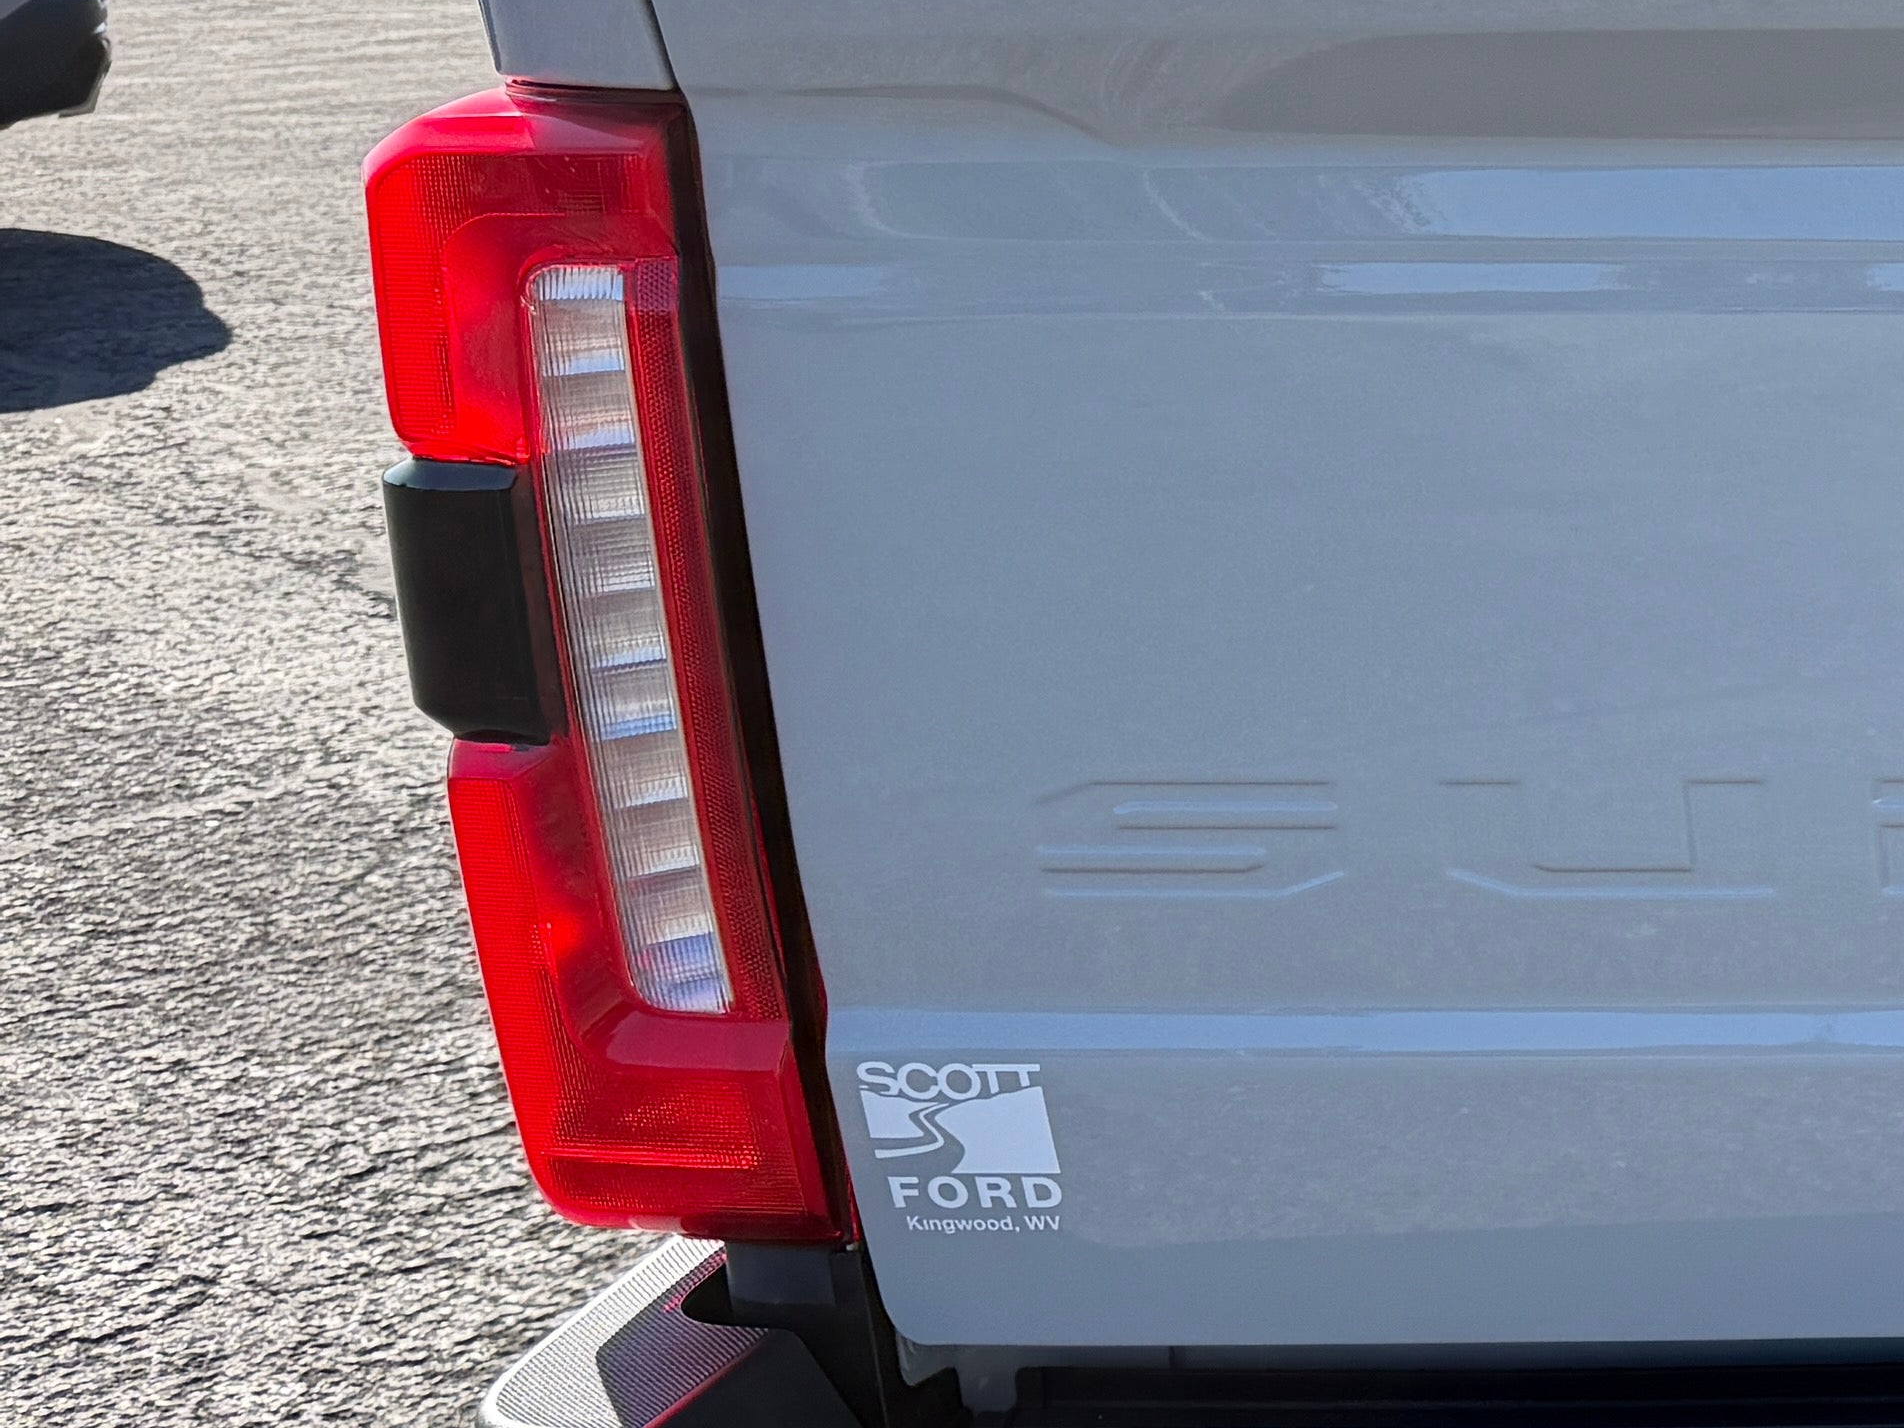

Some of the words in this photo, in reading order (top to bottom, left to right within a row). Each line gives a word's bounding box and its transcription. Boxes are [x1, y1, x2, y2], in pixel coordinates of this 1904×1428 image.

[856, 1060, 1041, 1100] SCOTT
[887, 1175, 1063, 1209] FORD
[906, 1215, 1020, 1234] Kingwood,
[1024, 1215, 1061, 1231] WV
